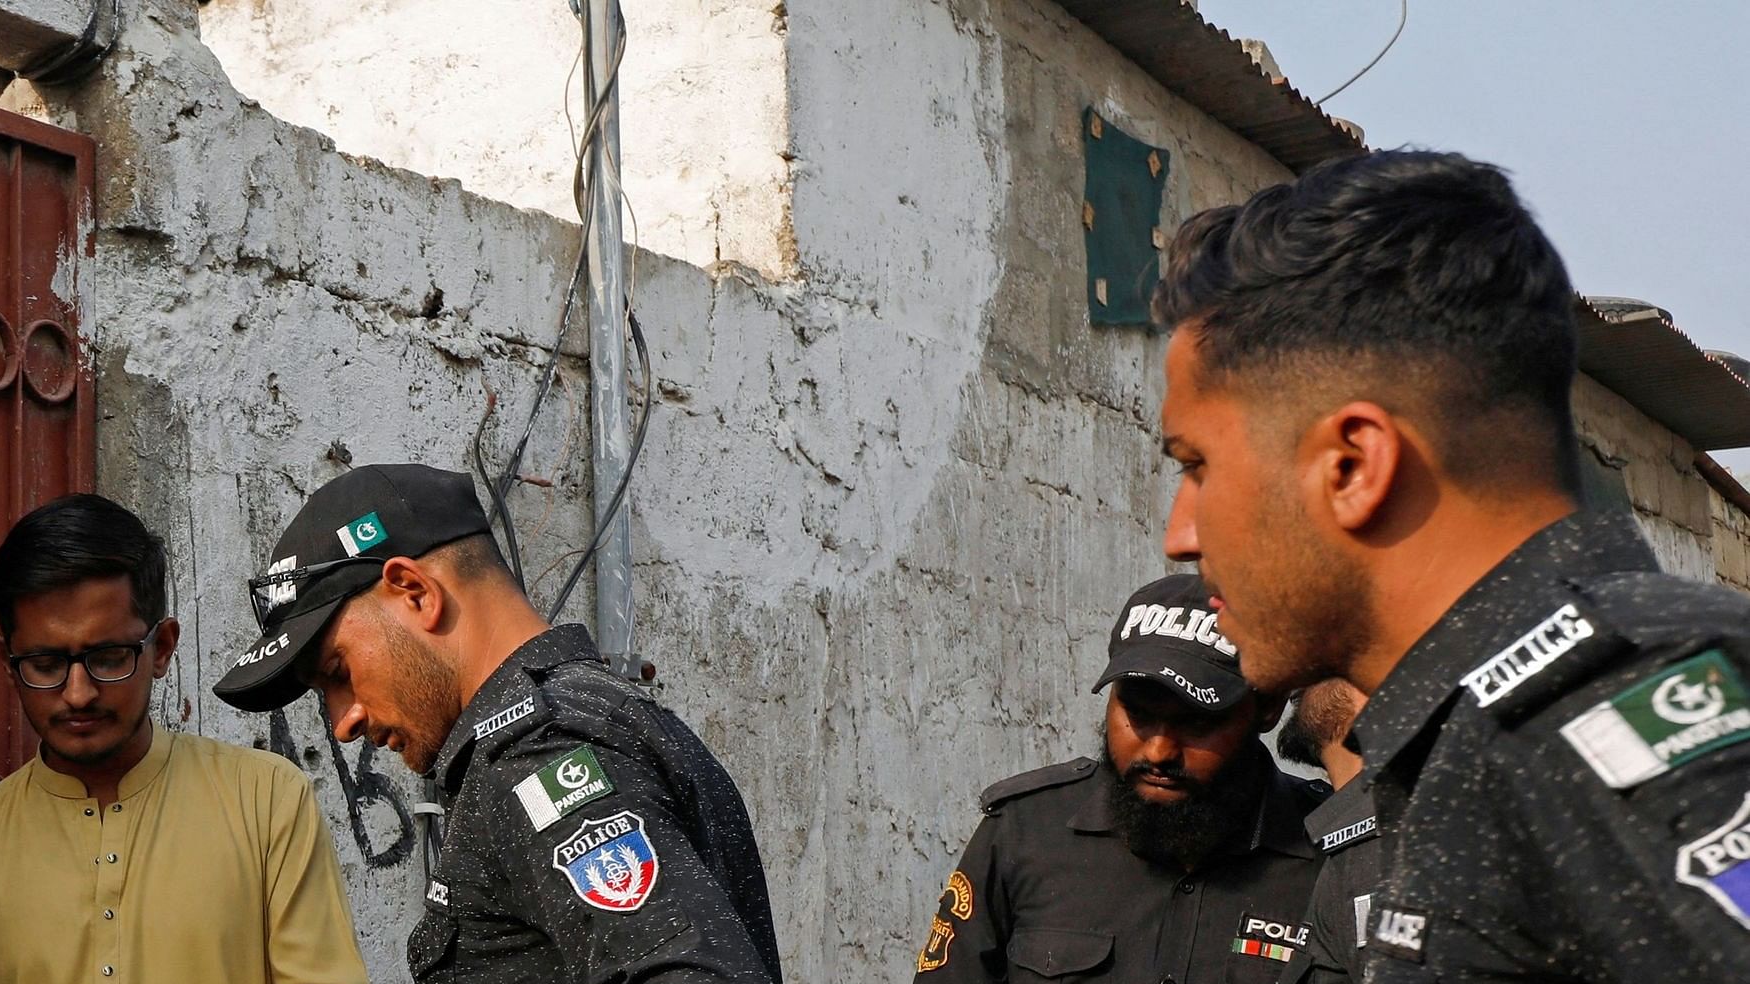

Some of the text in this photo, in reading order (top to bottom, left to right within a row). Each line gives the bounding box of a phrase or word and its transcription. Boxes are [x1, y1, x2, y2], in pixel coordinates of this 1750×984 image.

[1459, 604, 1595, 708] POLICE
[1159, 667, 1220, 704] POLICE
[473, 696, 536, 741] POLICE
[554, 779, 606, 812] PAKISTAN
[560, 816, 633, 865] POLICE
[1322, 816, 1376, 850] POLICE
[1692, 824, 1750, 876] PO
